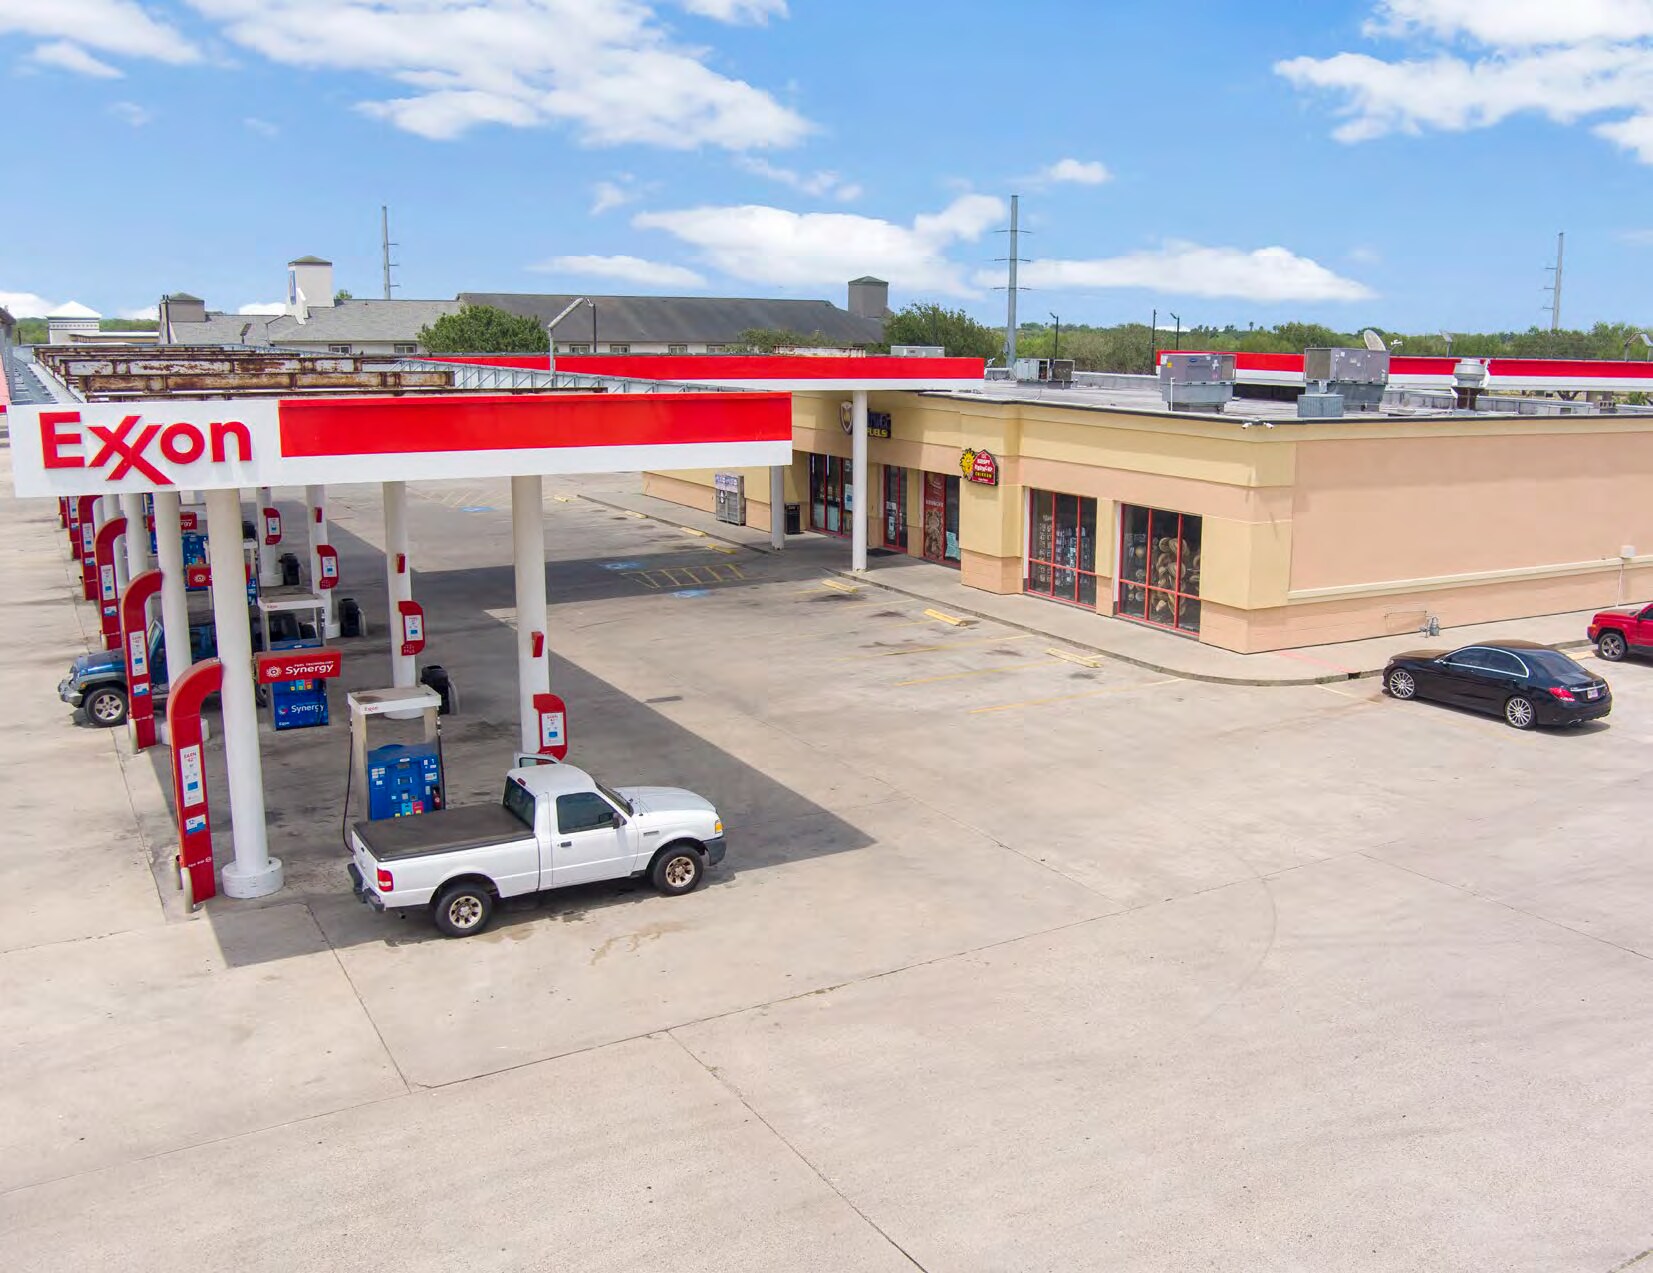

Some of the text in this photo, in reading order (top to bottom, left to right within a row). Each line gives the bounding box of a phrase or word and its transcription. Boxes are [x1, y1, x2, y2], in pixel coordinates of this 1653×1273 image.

[39, 411, 252, 486] Exxon
[285, 664, 334, 676] Synergy
[291, 704, 325, 715] Synergy
